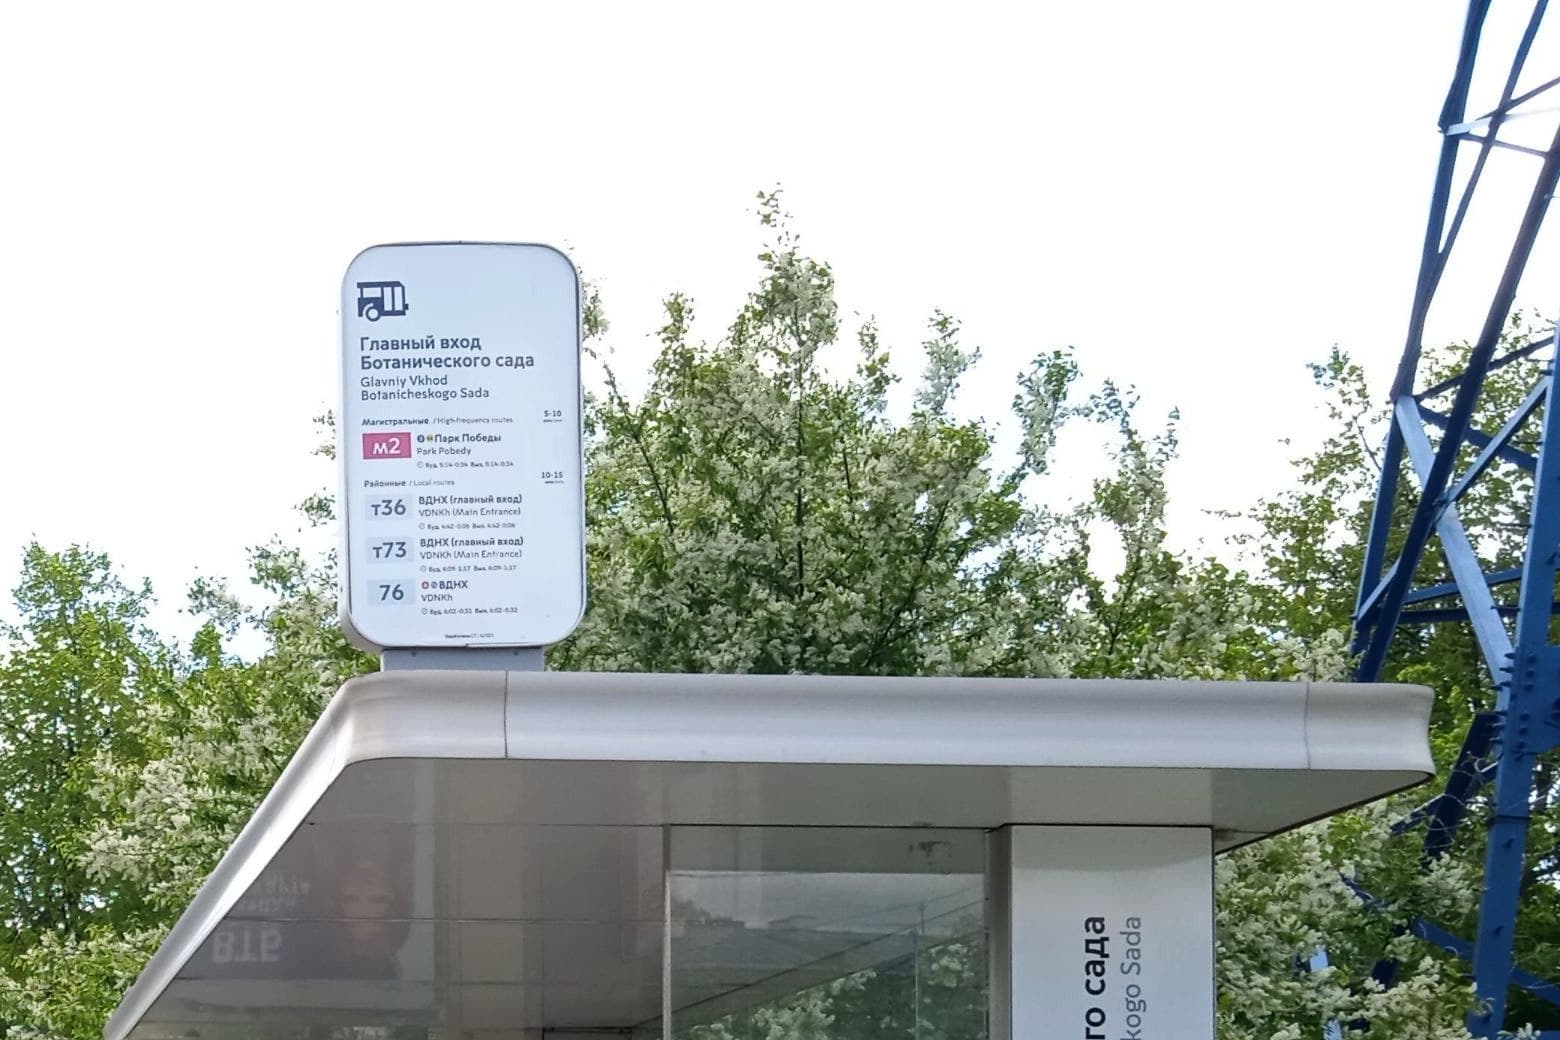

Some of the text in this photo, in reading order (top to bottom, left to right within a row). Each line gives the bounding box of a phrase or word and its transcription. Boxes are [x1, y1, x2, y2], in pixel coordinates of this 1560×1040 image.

[360, 335, 482, 351] Главный вход
[360, 354, 535, 370] Ботанического сада
[360, 374, 448, 388] Glavniy Vkhod
[361, 387, 489, 401] Botanicheskogo Sada
[361, 417, 429, 426] Магистральные
[434, 434, 460, 444] Парк
[462, 433, 501, 443] Победы
[417, 446, 471, 456] Park Pobedy
[541, 471, 563, 479] 10-15
[364, 480, 406, 488] Районные
[418, 493, 522, 506] ВДНХ (главный вход)
[371, 499, 406, 516] т36
[418, 507, 521, 517] VDNKh (Main Entrance)
[420, 536, 524, 548] ВДНХ (главный вход)
[372, 541, 407, 558] т73
[419, 549, 522, 559] VDNKh (Main Entrance)
[439, 580, 468, 590] ВДНХ
[379, 584, 404, 601] 76
[421, 594, 453, 602] VDNKh
[1120, 916, 1142, 976] Sada
[1084, 916, 1109, 995] сада
